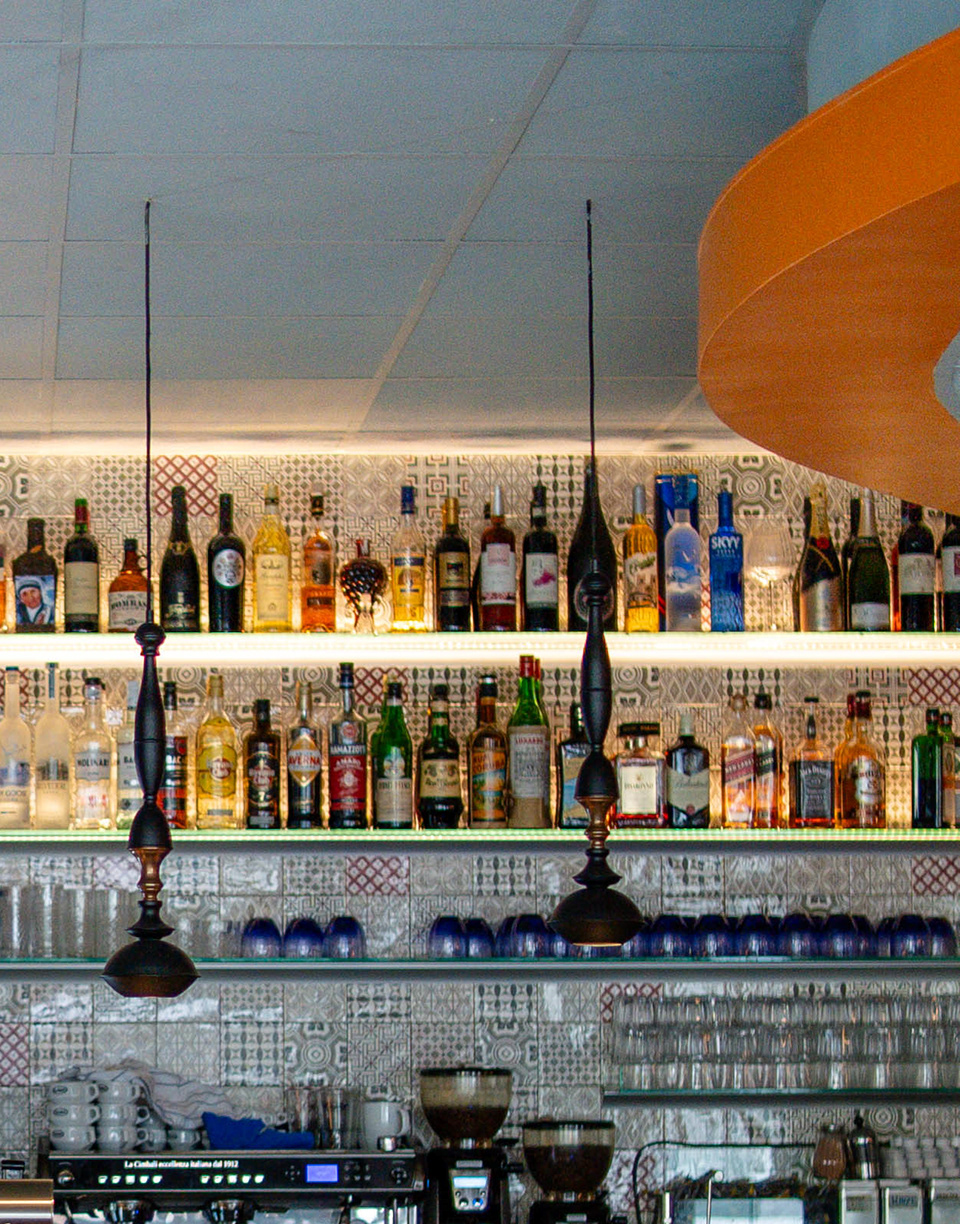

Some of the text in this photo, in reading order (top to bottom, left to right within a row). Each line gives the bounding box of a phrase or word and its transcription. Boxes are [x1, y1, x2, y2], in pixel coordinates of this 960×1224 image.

[710, 535, 741, 552] SKYY
[288, 755, 320, 766] AVERNA
[224, 1160, 239, 1169] 1912
